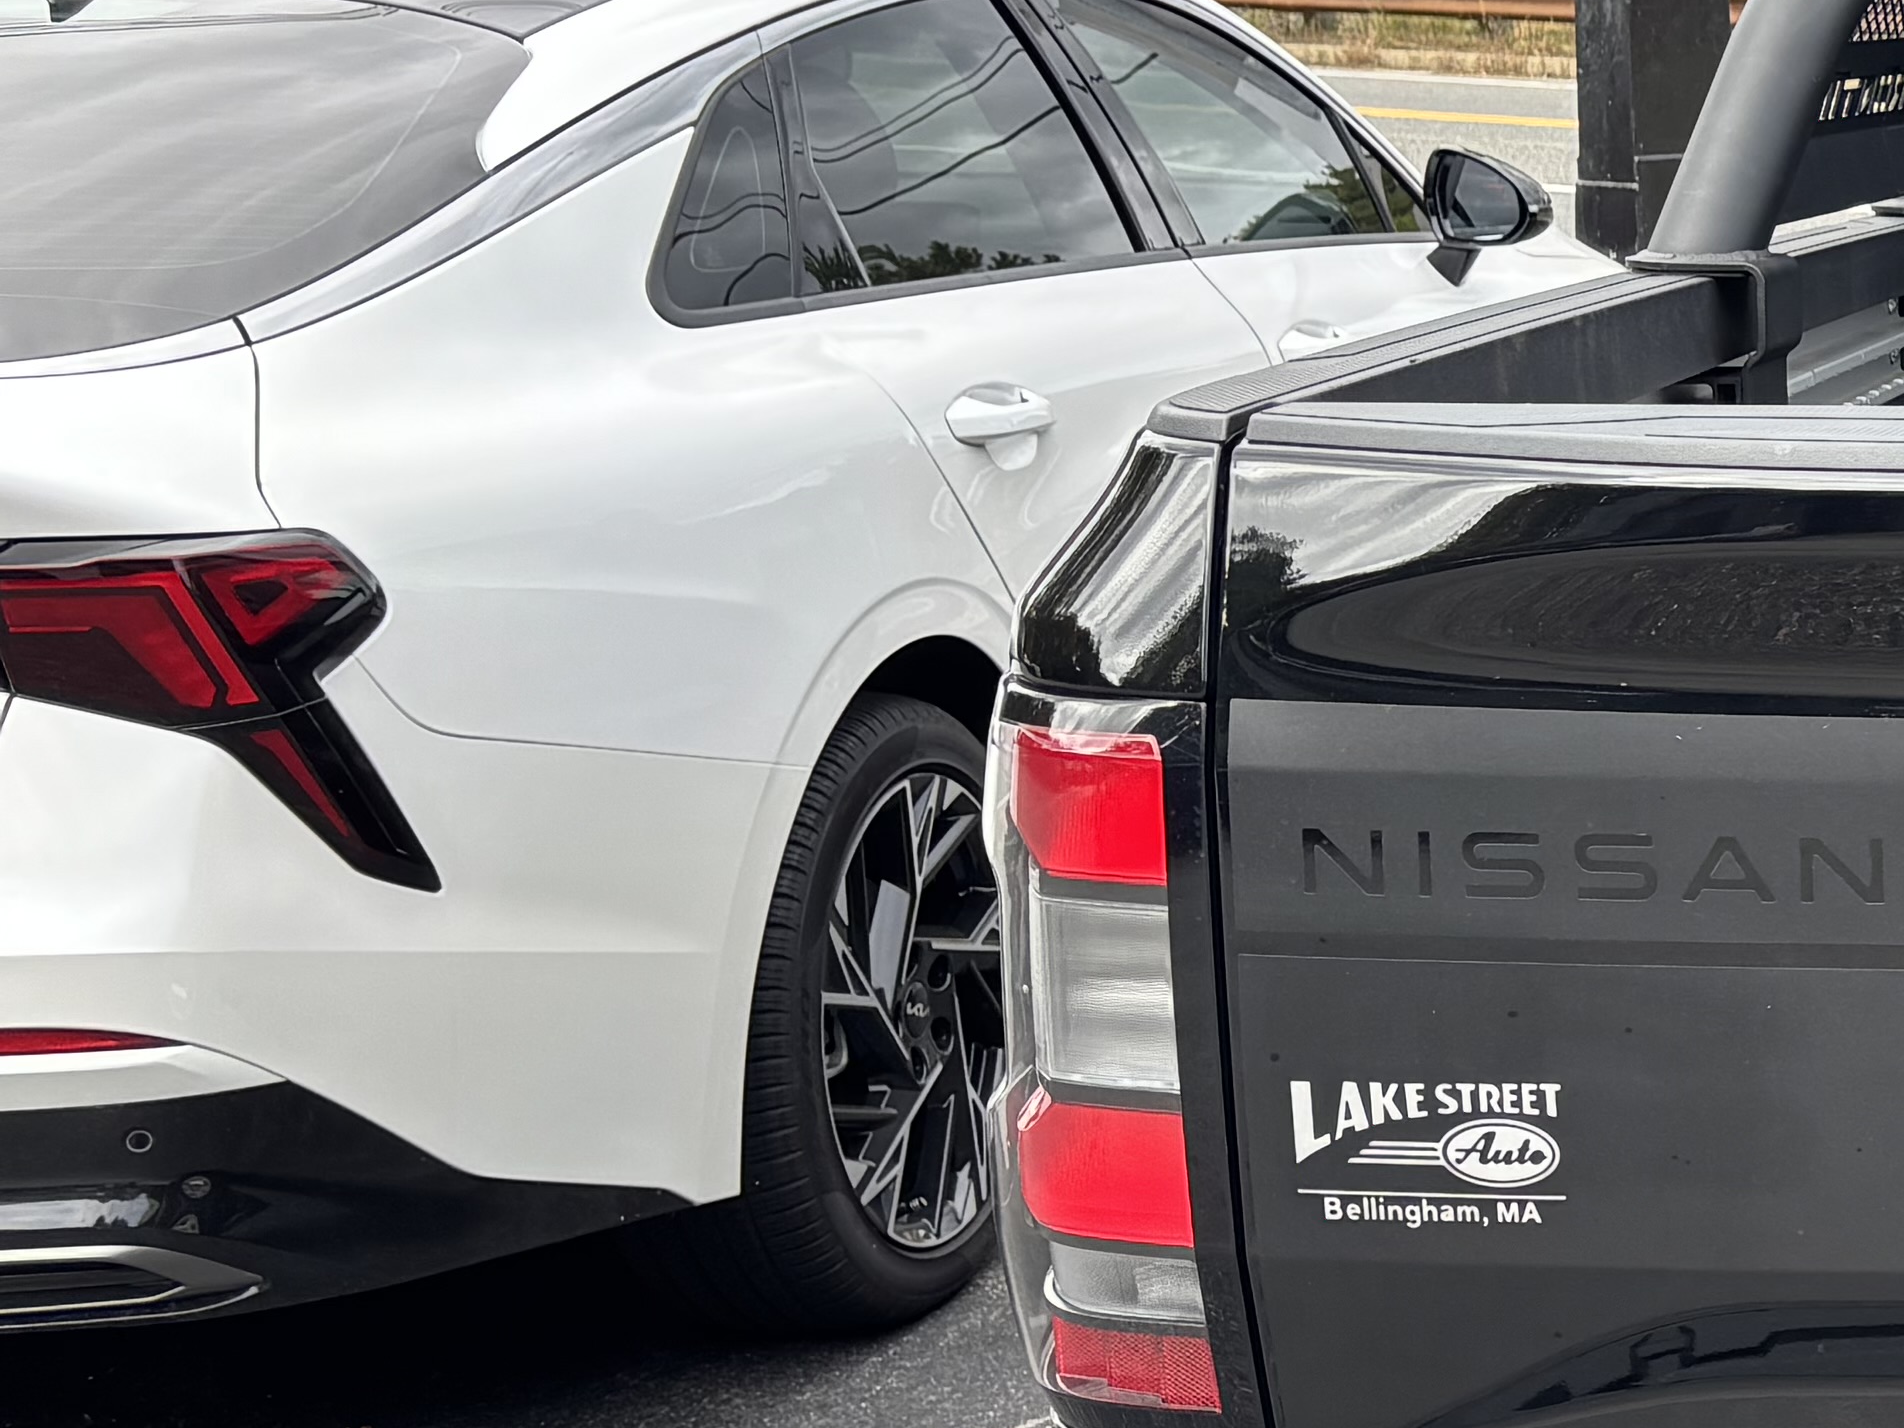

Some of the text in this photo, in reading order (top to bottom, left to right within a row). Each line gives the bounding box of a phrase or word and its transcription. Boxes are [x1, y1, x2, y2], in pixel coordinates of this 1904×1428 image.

[1301, 827, 1886, 906] NISSAN
[1290, 1080, 1562, 1164] LAKE STREET
[1455, 1131, 1547, 1165] Auto
[1323, 1196, 1543, 1229] Bellingham, MA
